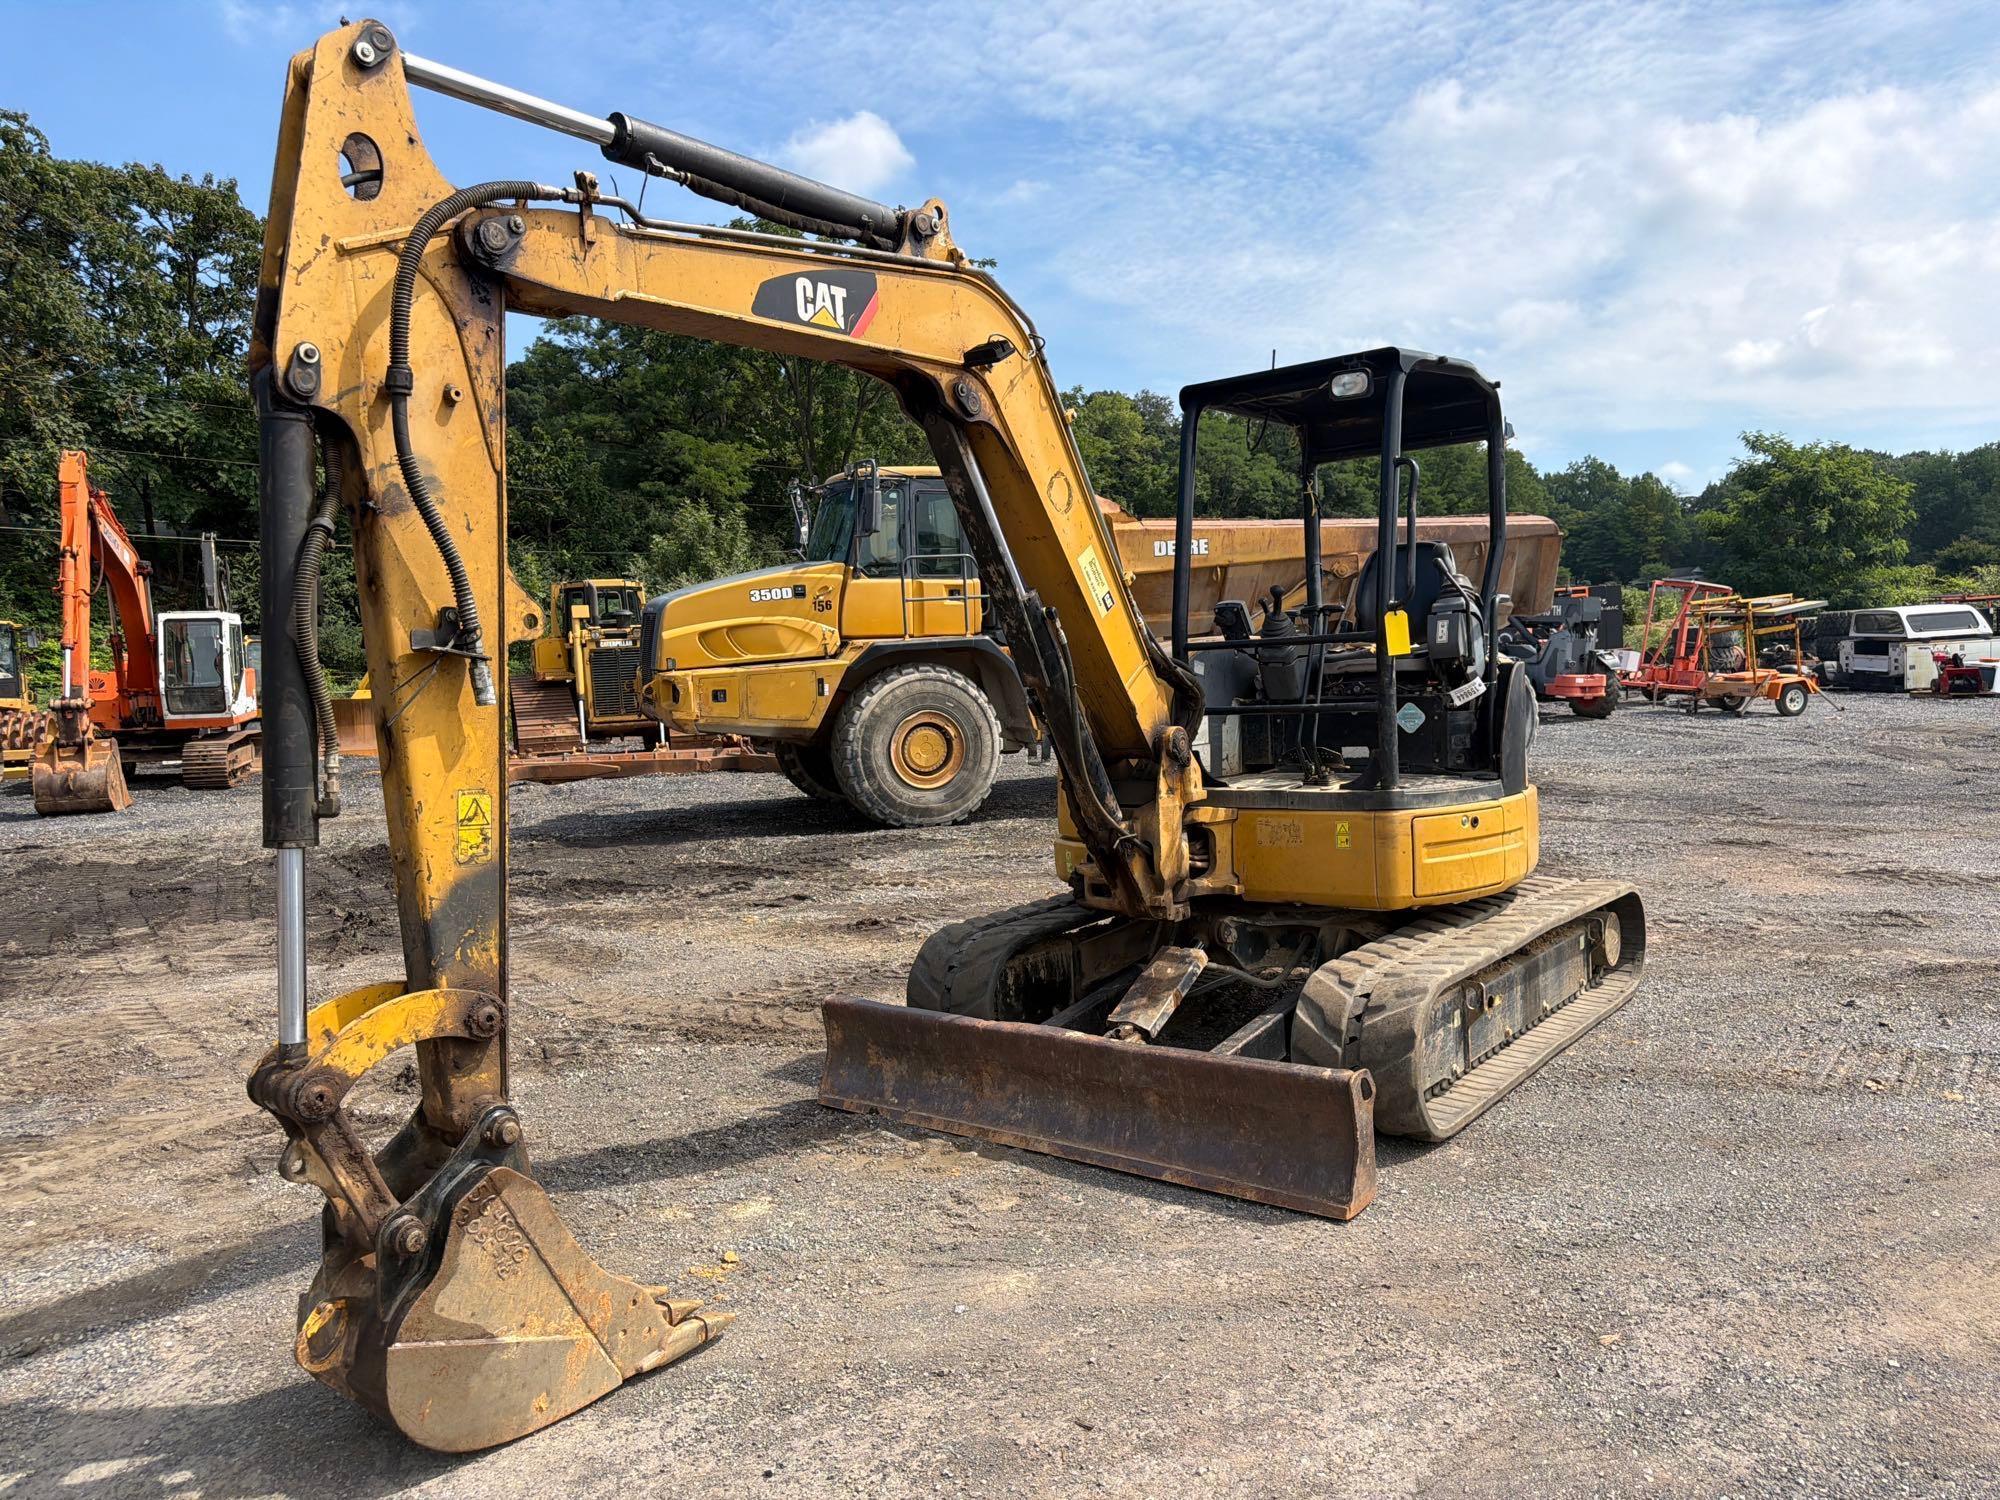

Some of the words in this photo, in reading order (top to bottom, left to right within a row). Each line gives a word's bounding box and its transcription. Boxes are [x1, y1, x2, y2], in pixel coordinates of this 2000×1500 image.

[795, 277, 847, 330] CAT
[1153, 538, 1209, 558] DERE
[749, 587, 793, 602] 350D
[812, 600, 832, 613] 156
